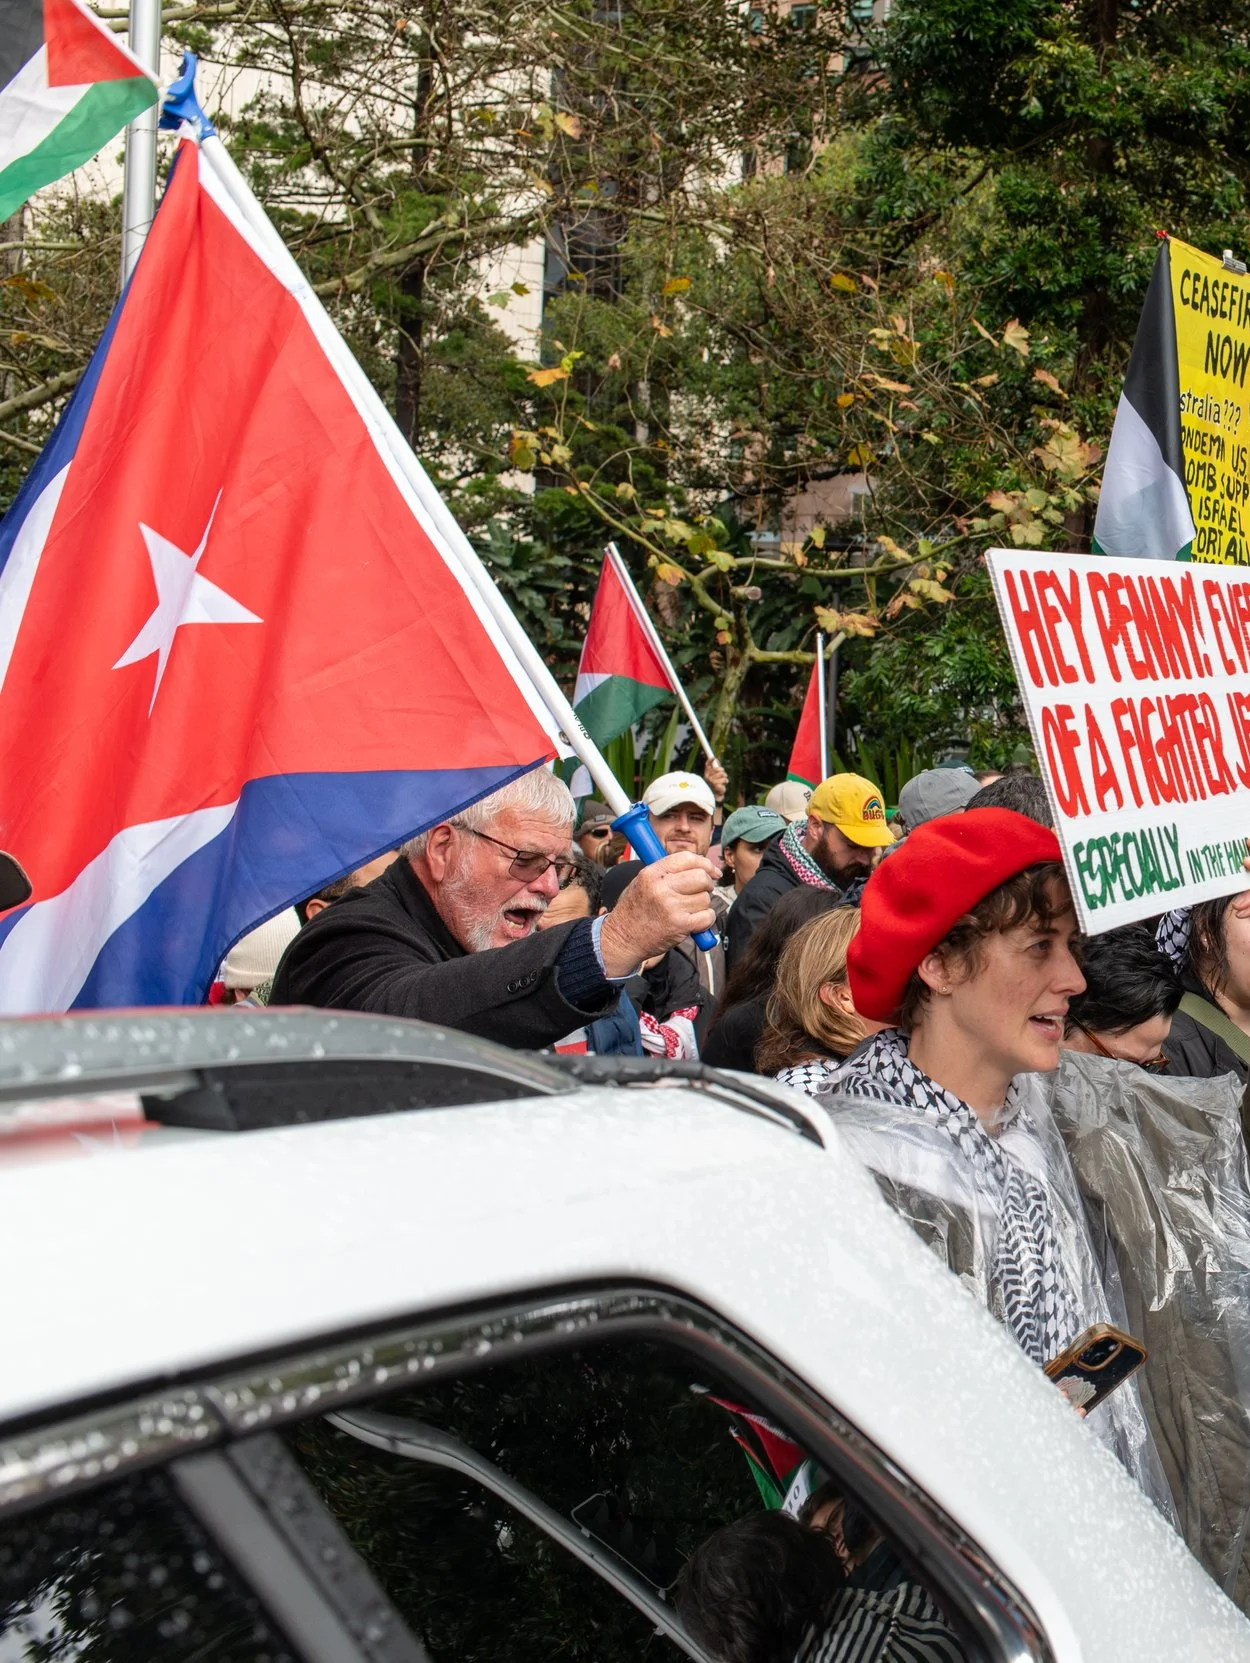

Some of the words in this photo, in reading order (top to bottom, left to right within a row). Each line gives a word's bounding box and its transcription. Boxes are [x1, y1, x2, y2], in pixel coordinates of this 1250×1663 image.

[1181, 426, 1226, 462] ONDEMN
[1187, 458, 1217, 493] OMB
[1198, 496, 1246, 538] ISRAEL
[1197, 526, 1224, 557] ORT
[1004, 568, 1096, 688] HEY
[1087, 570, 1214, 684] PENNY!
[1041, 703, 1091, 820] OF
[1085, 702, 1125, 813] A
[1111, 691, 1238, 809] FIGHTER
[1072, 821, 1186, 911] ESPECIALLY
[1186, 846, 1204, 885] IN
[1201, 843, 1227, 880] THE
